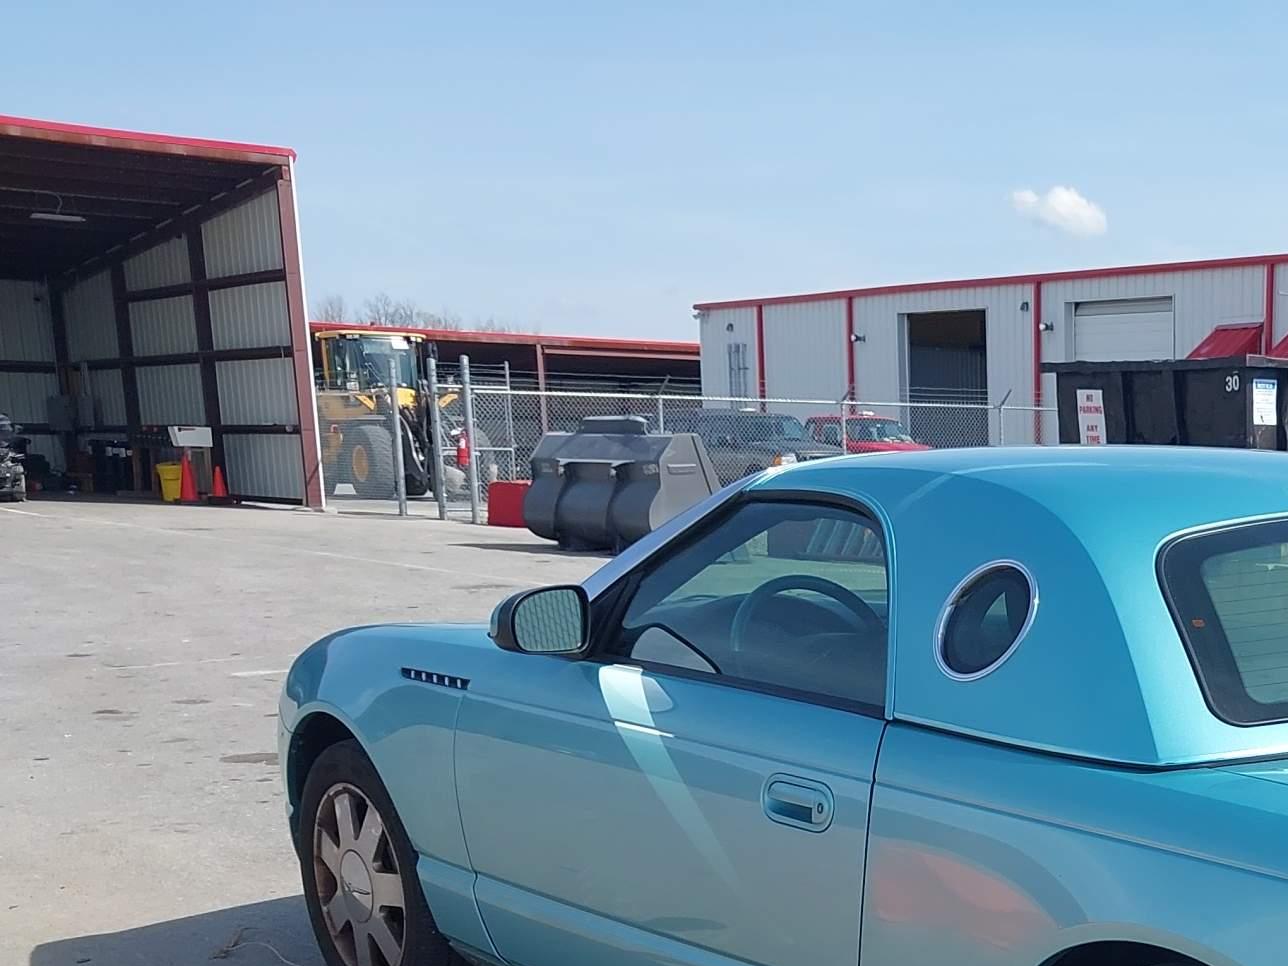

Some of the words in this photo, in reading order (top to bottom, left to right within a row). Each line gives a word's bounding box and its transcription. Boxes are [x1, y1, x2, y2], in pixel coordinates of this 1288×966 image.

[1225, 375, 1240, 392] 30
[1079, 405, 1103, 415] PARKING
[1086, 424, 1099, 433] ANY
